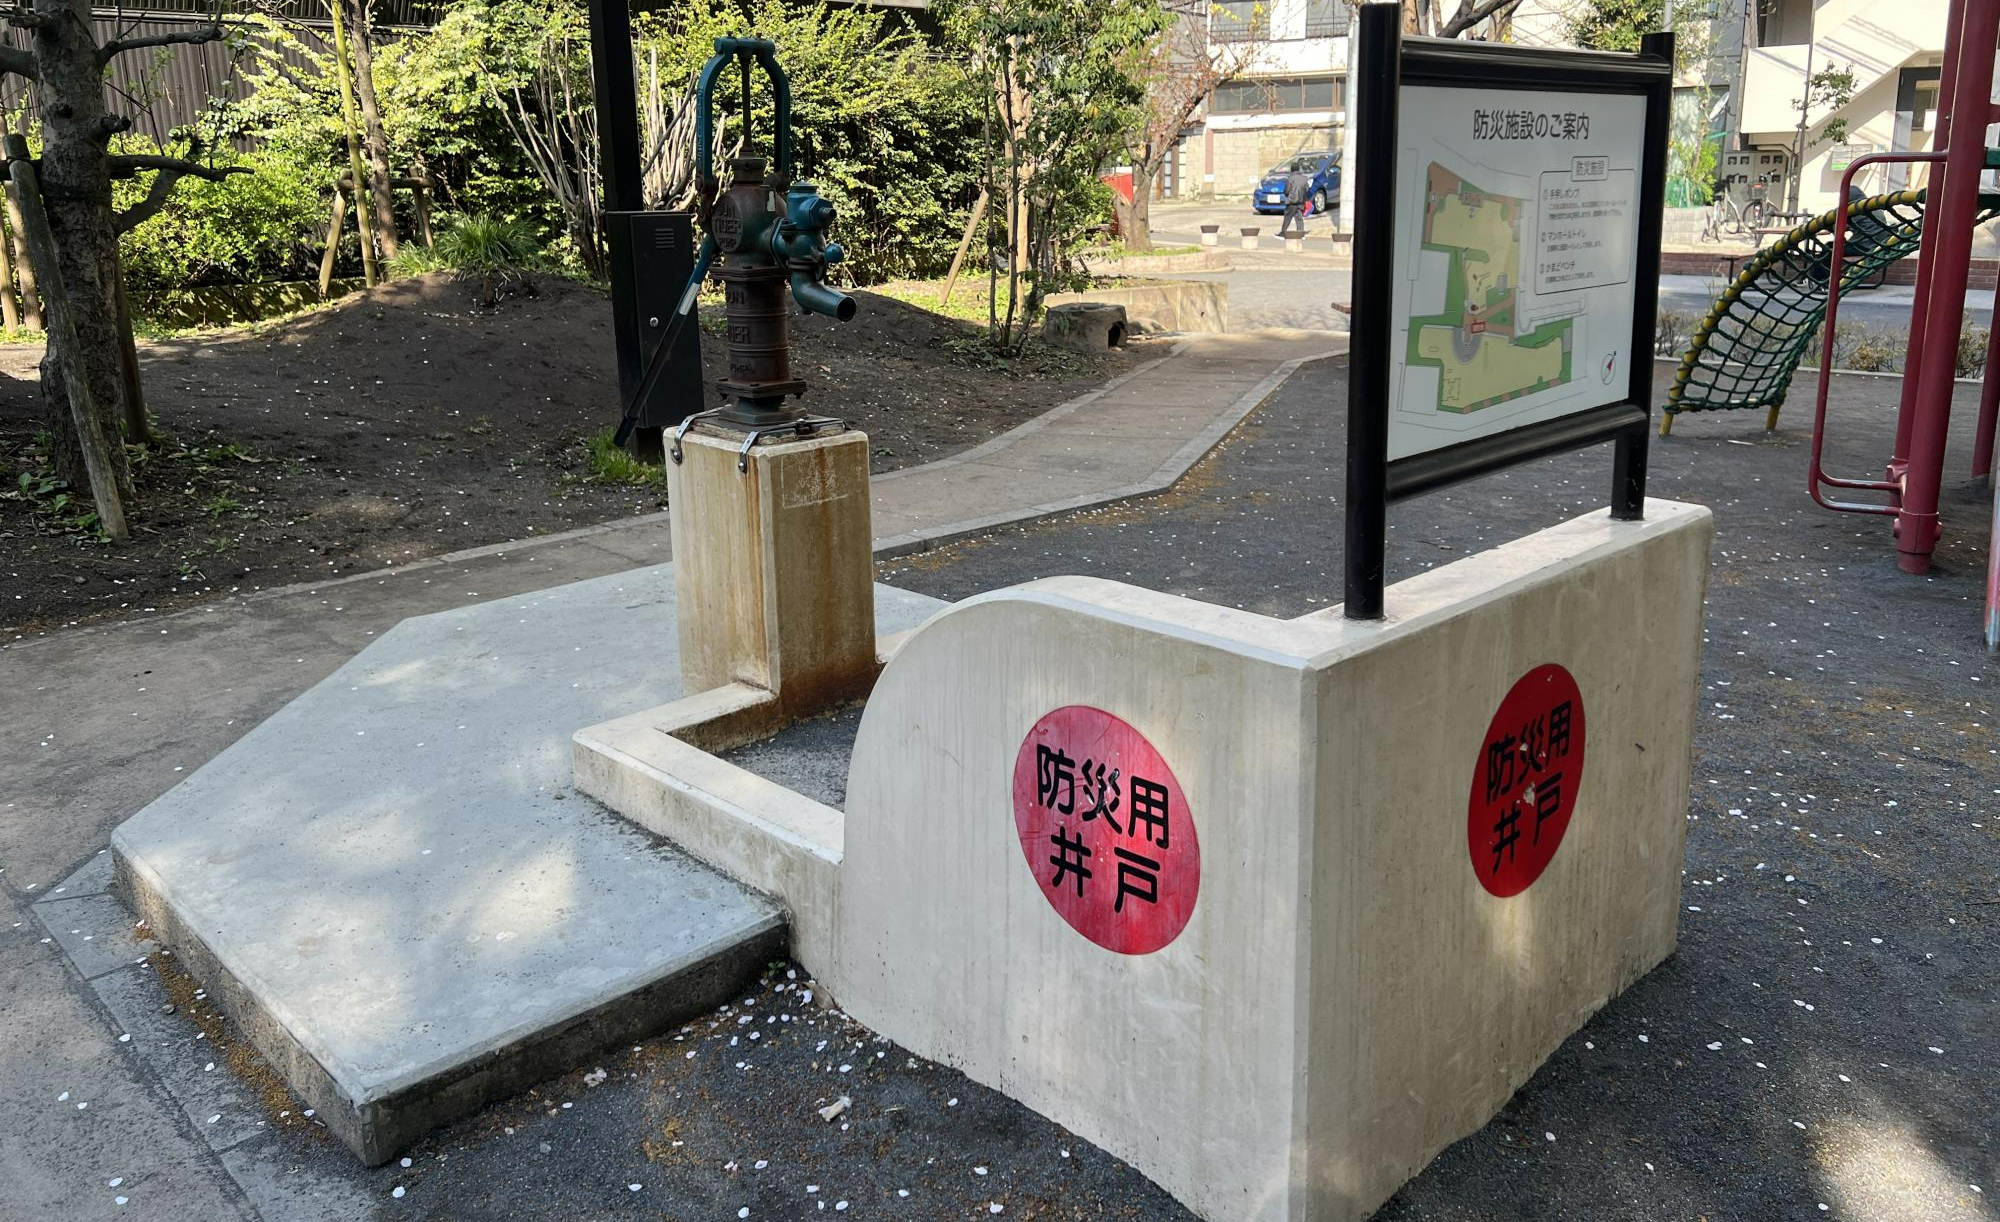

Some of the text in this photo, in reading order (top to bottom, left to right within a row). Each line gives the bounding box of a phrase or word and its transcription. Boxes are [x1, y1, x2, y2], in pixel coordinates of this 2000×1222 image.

[1473, 109, 1590, 141] 防災施設のご案内
[1576, 160, 1605, 176] 防災施設
[712, 218, 741, 235] TIGER
[1036, 743, 1169, 850] 防災用
[1485, 699, 1572, 806] 防災用
[1492, 771, 1565, 876] 井戸
[1049, 825, 1161, 914] 井戸
